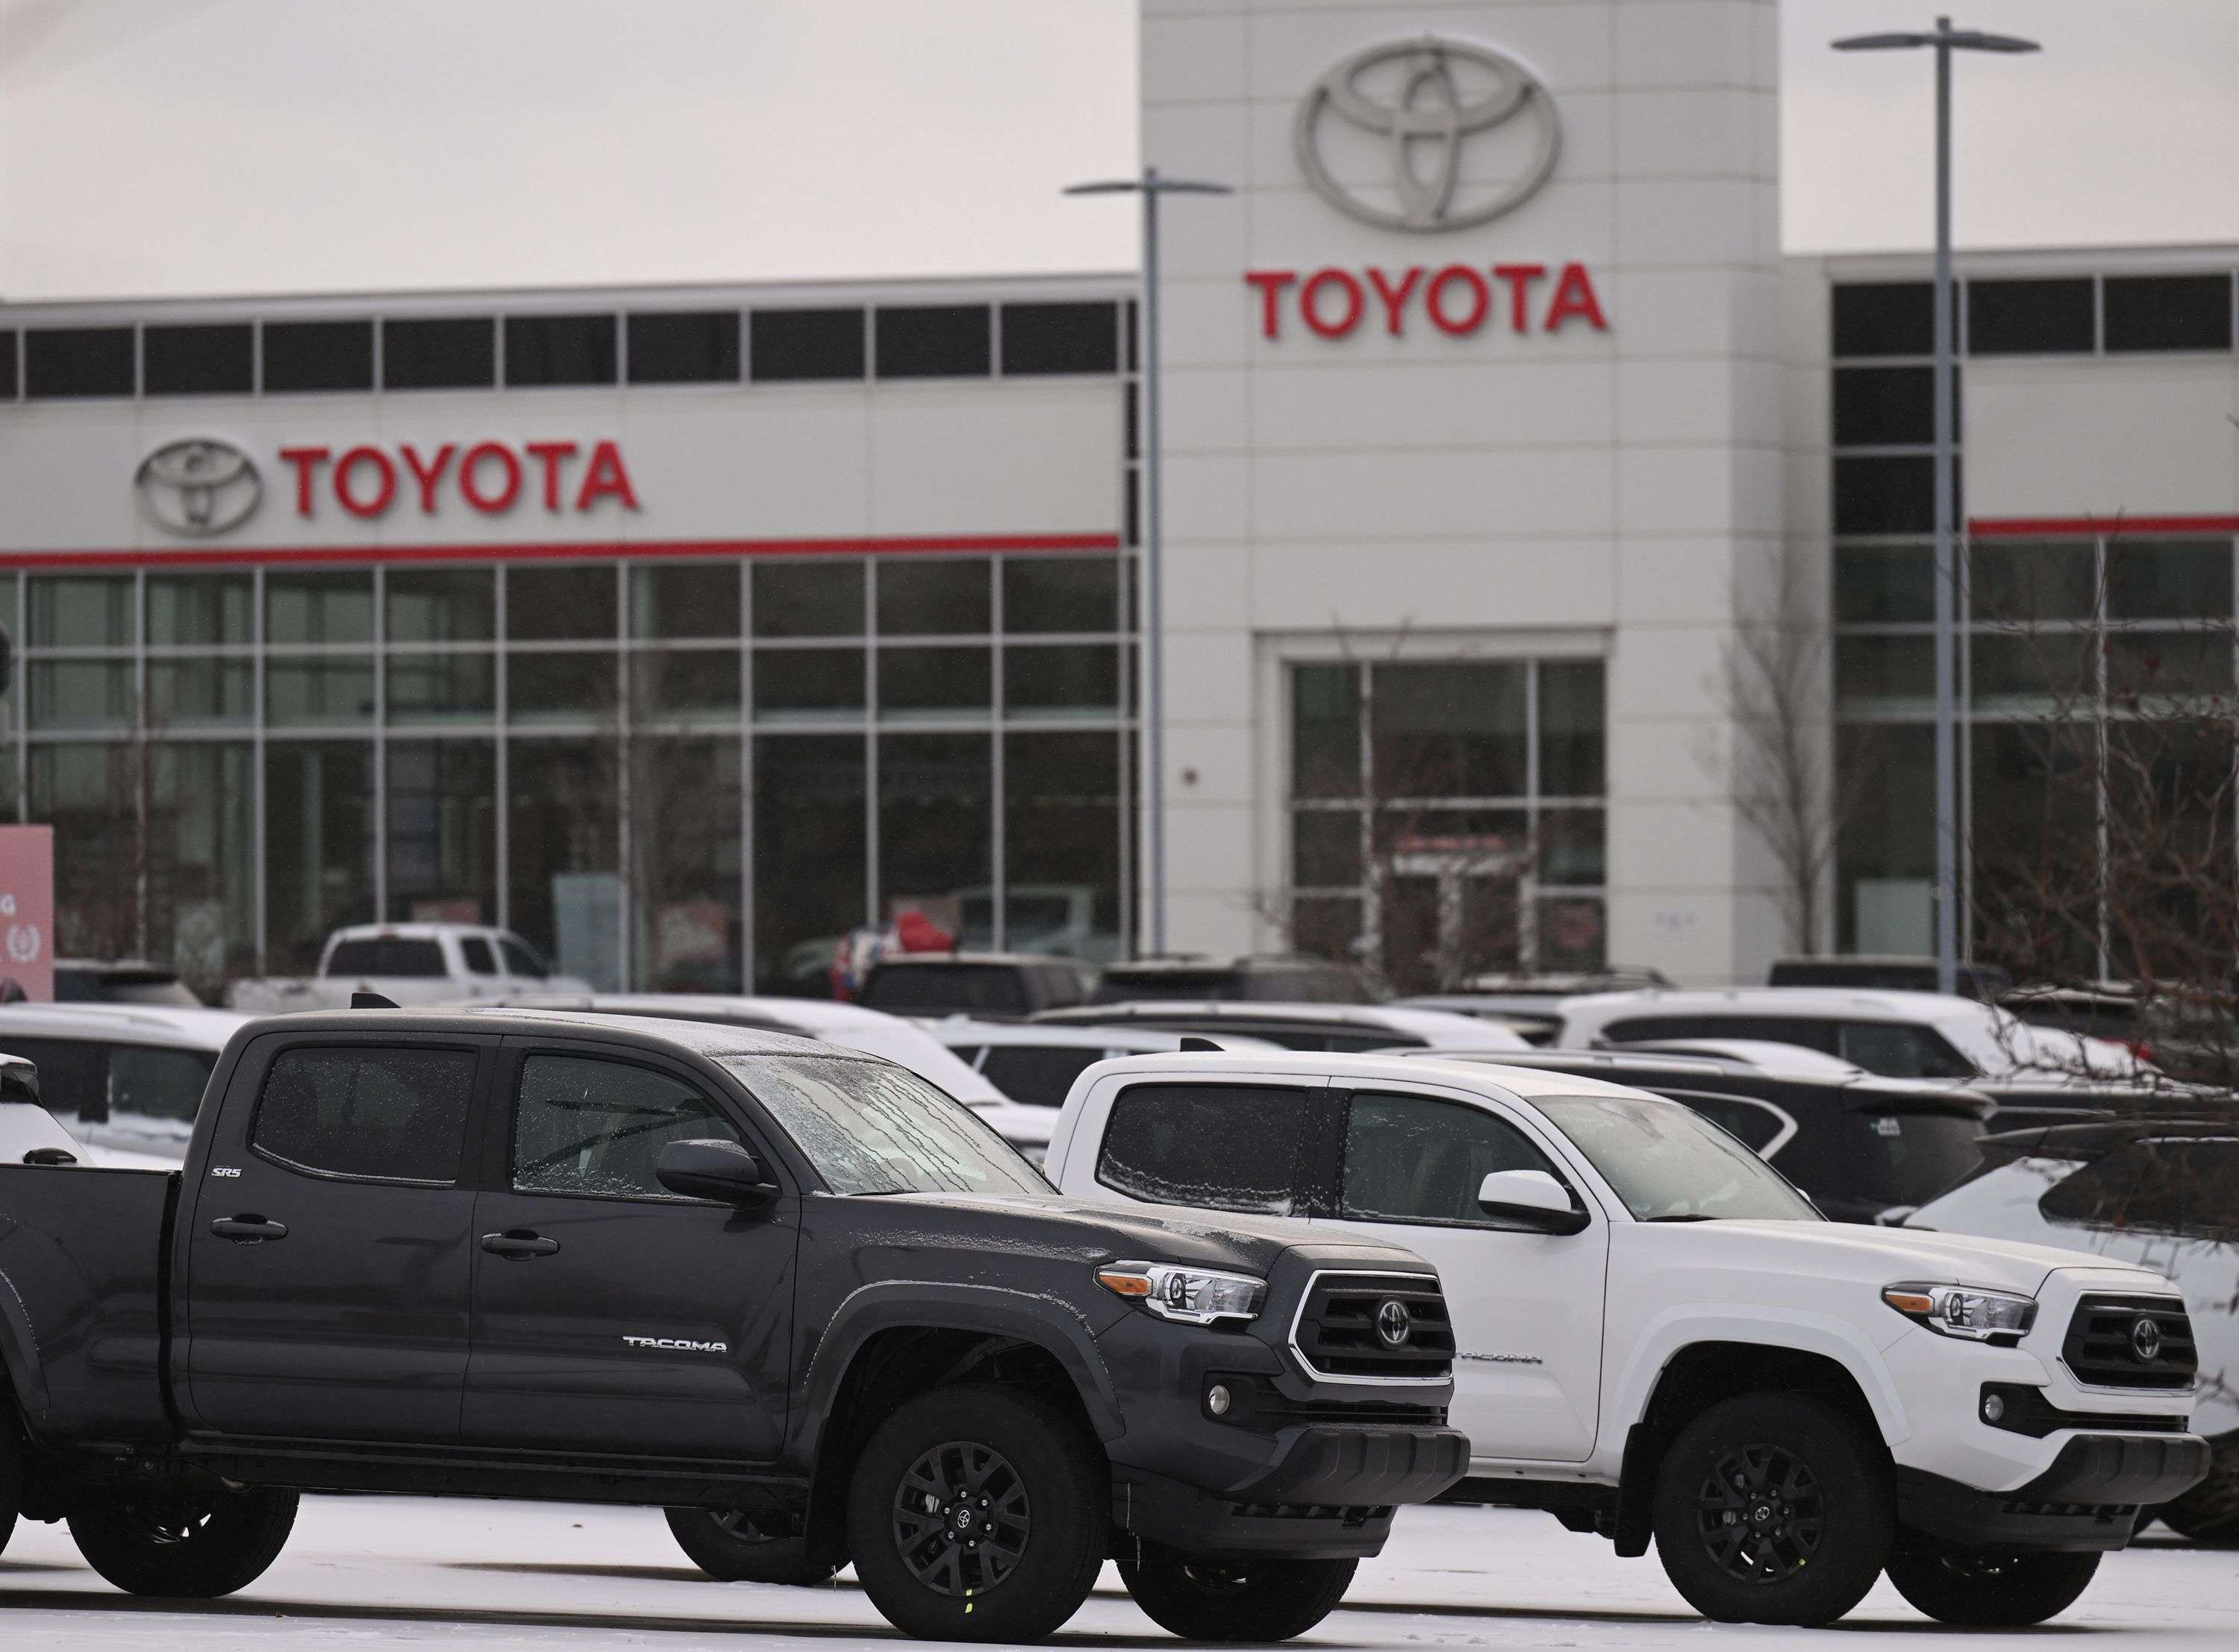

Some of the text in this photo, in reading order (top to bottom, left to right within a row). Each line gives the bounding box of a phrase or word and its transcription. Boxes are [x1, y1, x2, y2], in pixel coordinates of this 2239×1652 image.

[1243, 262, 1609, 341] TOYOTA
[278, 440, 640, 519] TOYOTA
[0, 893, 16, 915] G
[212, 1167, 243, 1177] SR5
[622, 1336, 728, 1353] TACOMA
